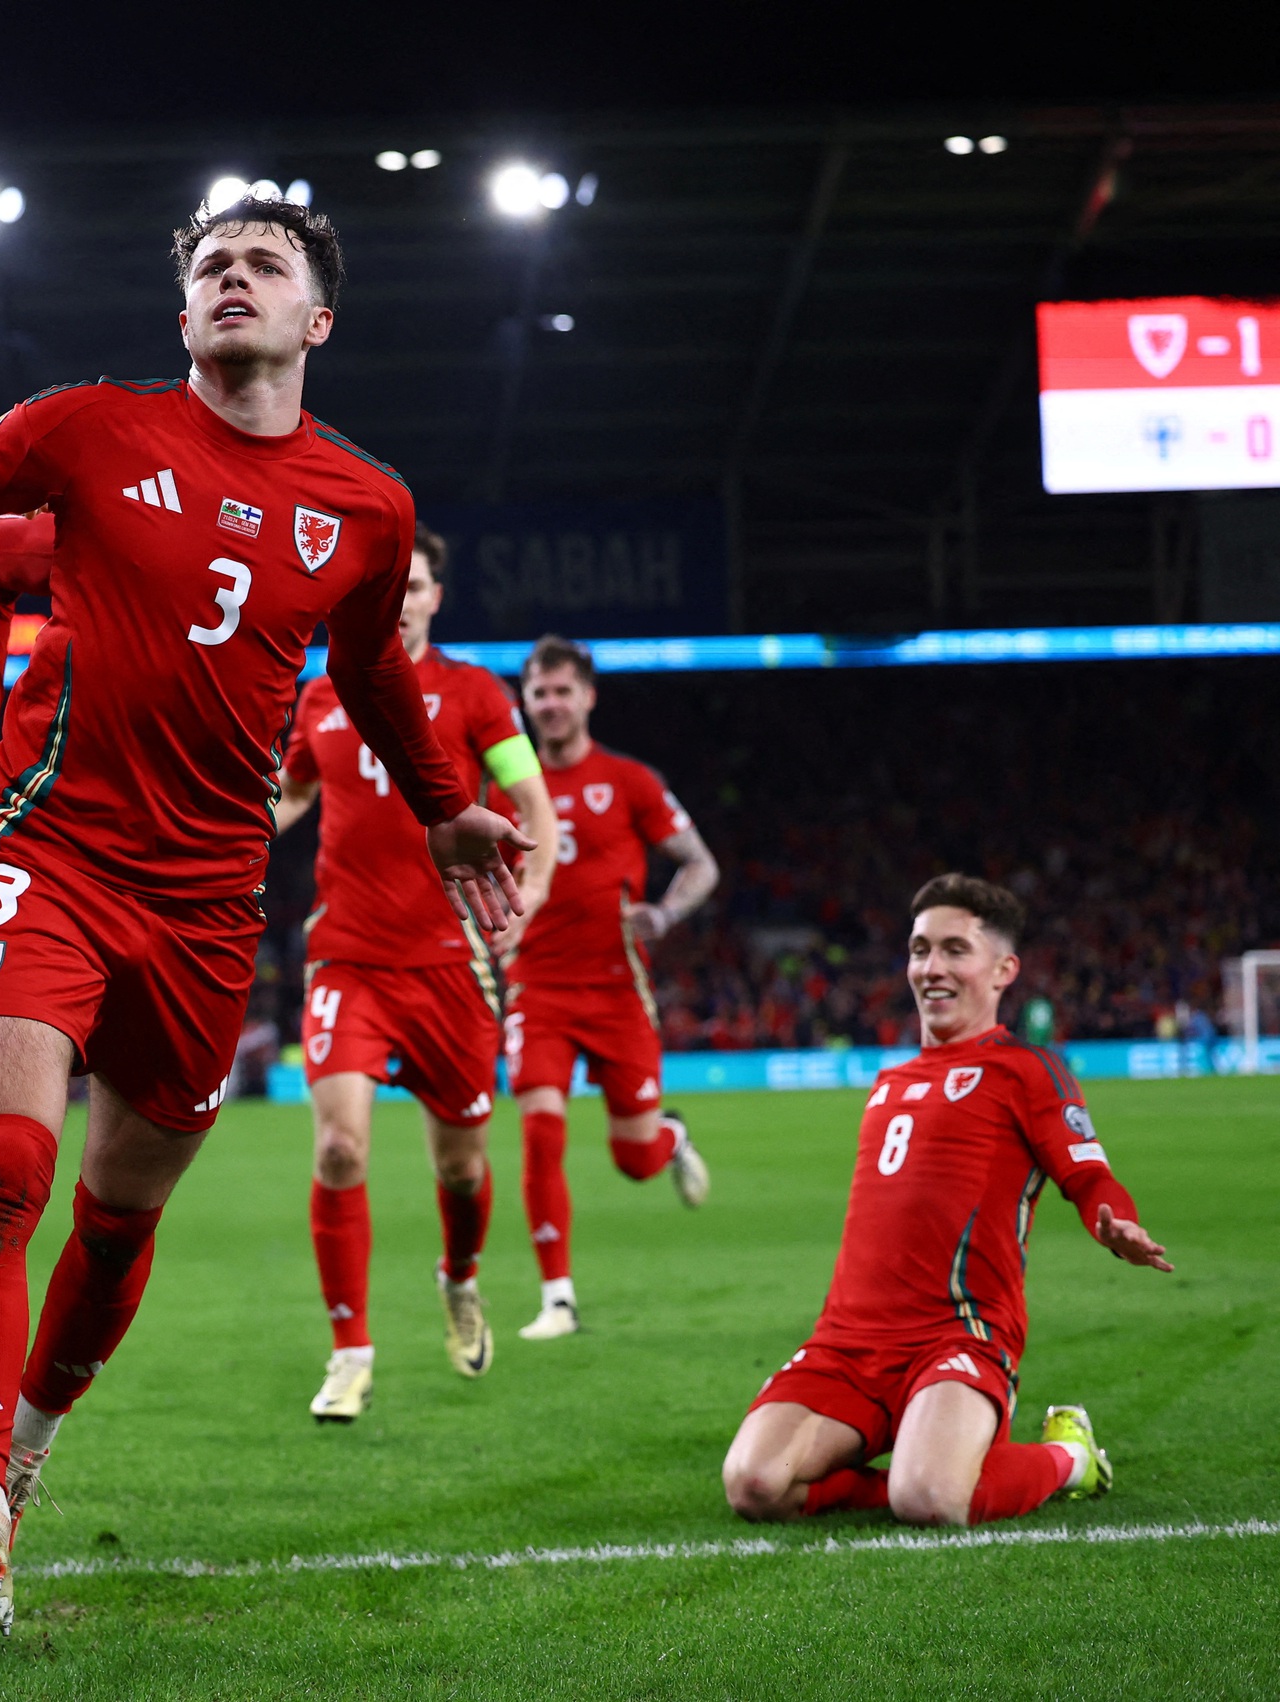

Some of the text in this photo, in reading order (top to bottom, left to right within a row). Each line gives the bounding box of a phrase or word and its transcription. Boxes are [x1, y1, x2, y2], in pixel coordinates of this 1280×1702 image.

[477, 529, 682, 608] SABAH
[187, 557, 253, 646] 3
[357, 742, 390, 798] 4
[310, 984, 342, 1030] 4
[876, 1113, 915, 1177] 8
